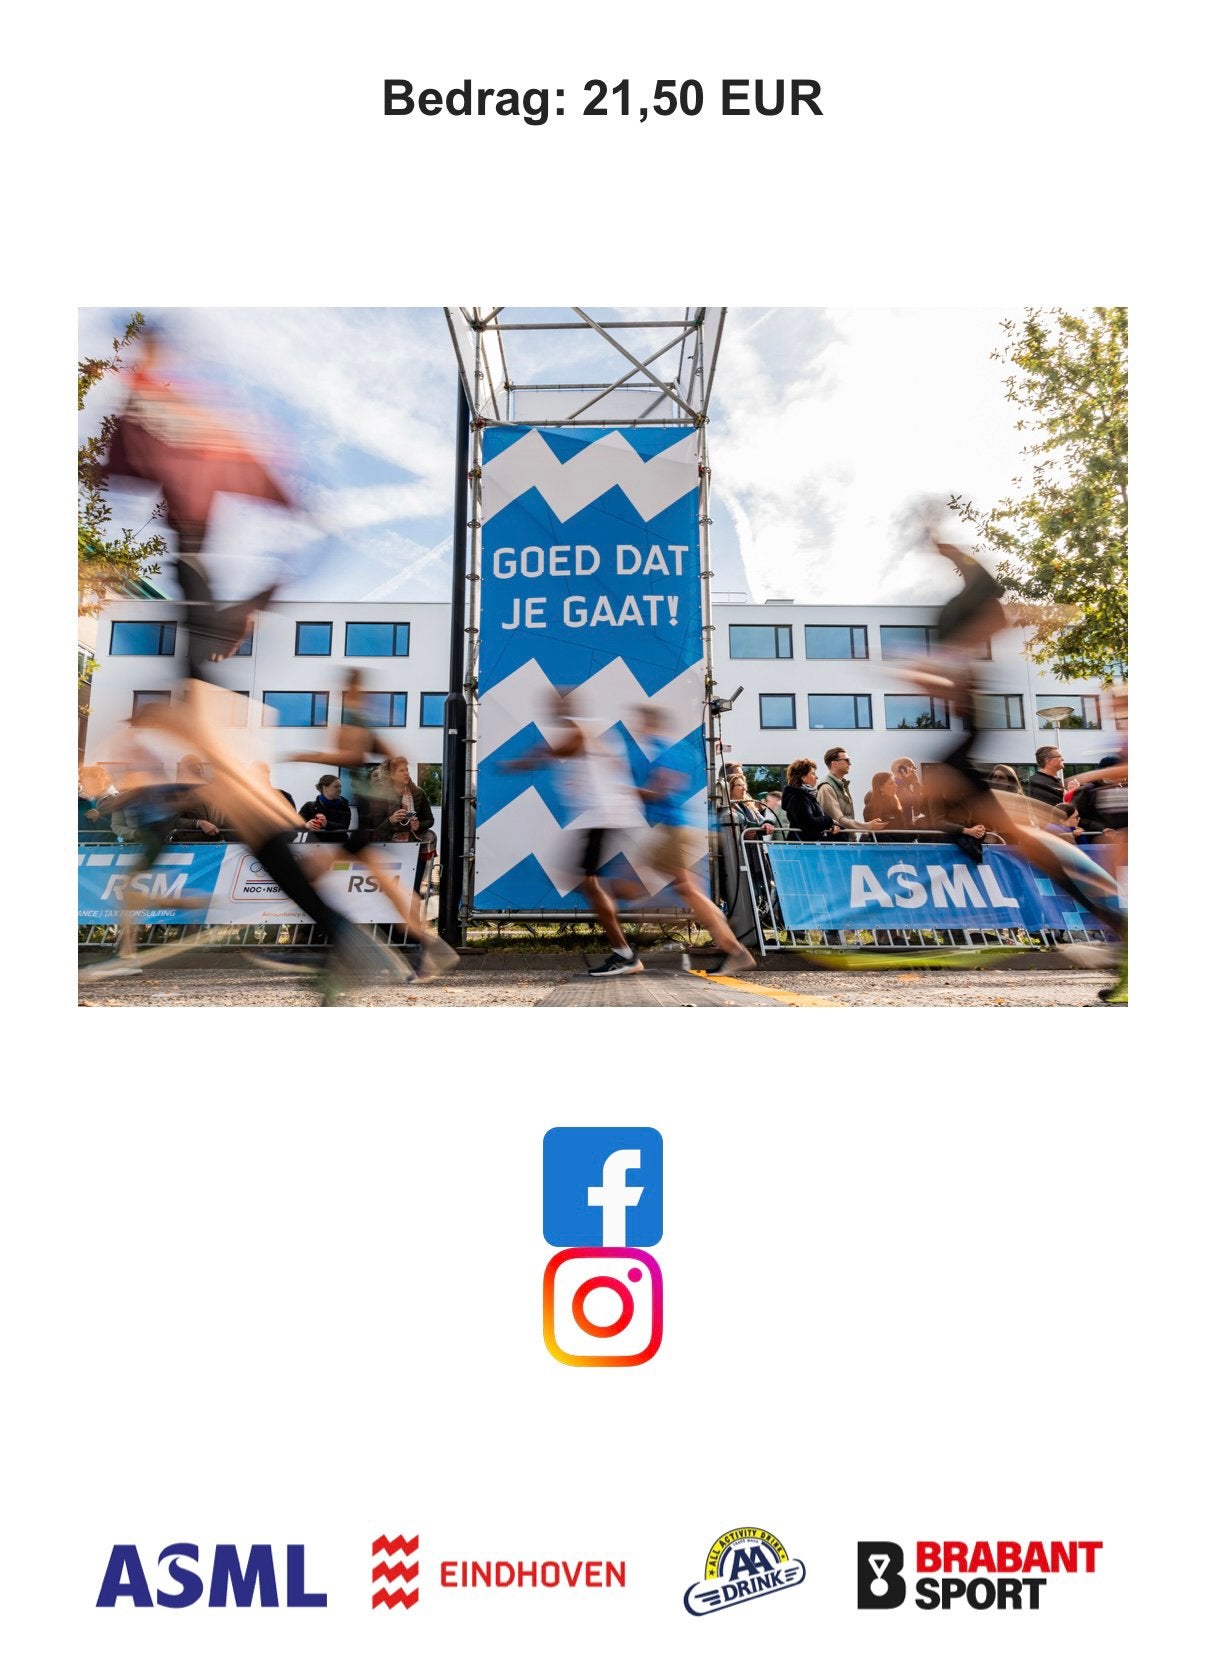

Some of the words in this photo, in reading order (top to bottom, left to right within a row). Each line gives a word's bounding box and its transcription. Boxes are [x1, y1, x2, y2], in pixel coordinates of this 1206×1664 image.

[384, 79, 565, 126] Bedrag:
[582, 78, 704, 124] 21,50
[722, 79, 824, 116] EUR
[493, 545, 601, 580] GOED
[616, 544, 689, 577] DAT
[501, 597, 547, 630] JE
[563, 595, 679, 627] GAAT!
[101, 873, 189, 900] RSM
[850, 862, 1020, 910] ASML
[708, 1548, 721, 1567] ALL
[719, 1529, 757, 1549] ACTIVITY
[729, 1545, 775, 1582] AA
[916, 1541, 1104, 1573] BRABANT
[95, 1542, 328, 1609] ASML
[440, 1561, 626, 1588] EINDHOVEN
[721, 1569, 785, 1602] DRINK
[915, 1577, 1047, 1611] SPORT
